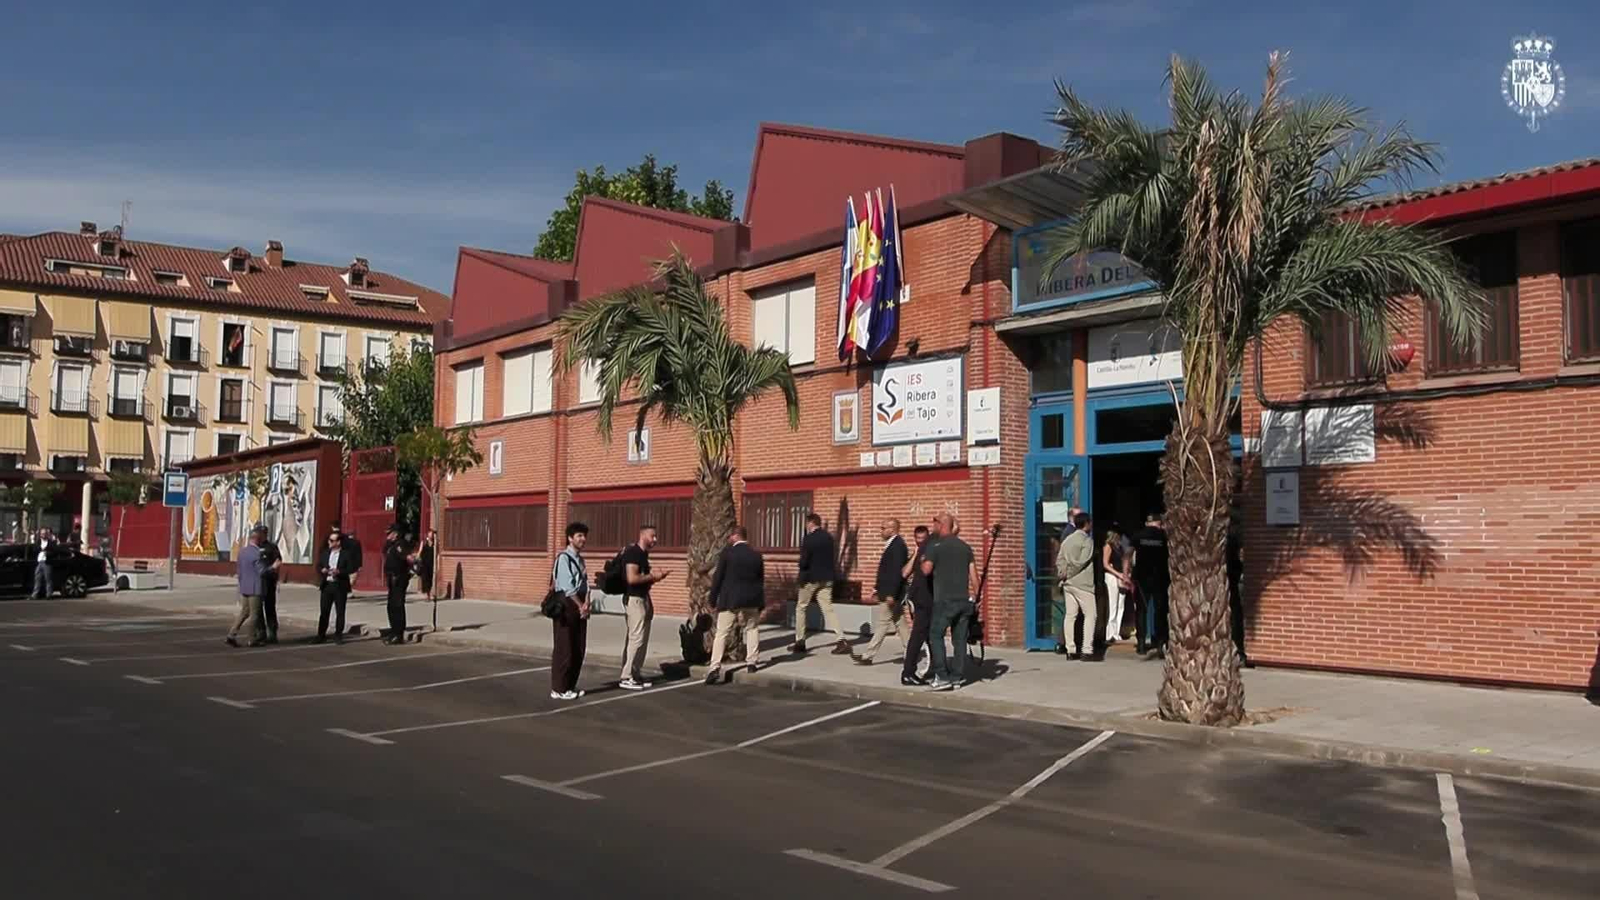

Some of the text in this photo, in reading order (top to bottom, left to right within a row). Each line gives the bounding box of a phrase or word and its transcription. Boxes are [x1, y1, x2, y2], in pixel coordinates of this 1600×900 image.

[907, 373, 921, 385] IES
[907, 390, 936, 402] Ribera
[917, 406, 936, 421] Tajo
